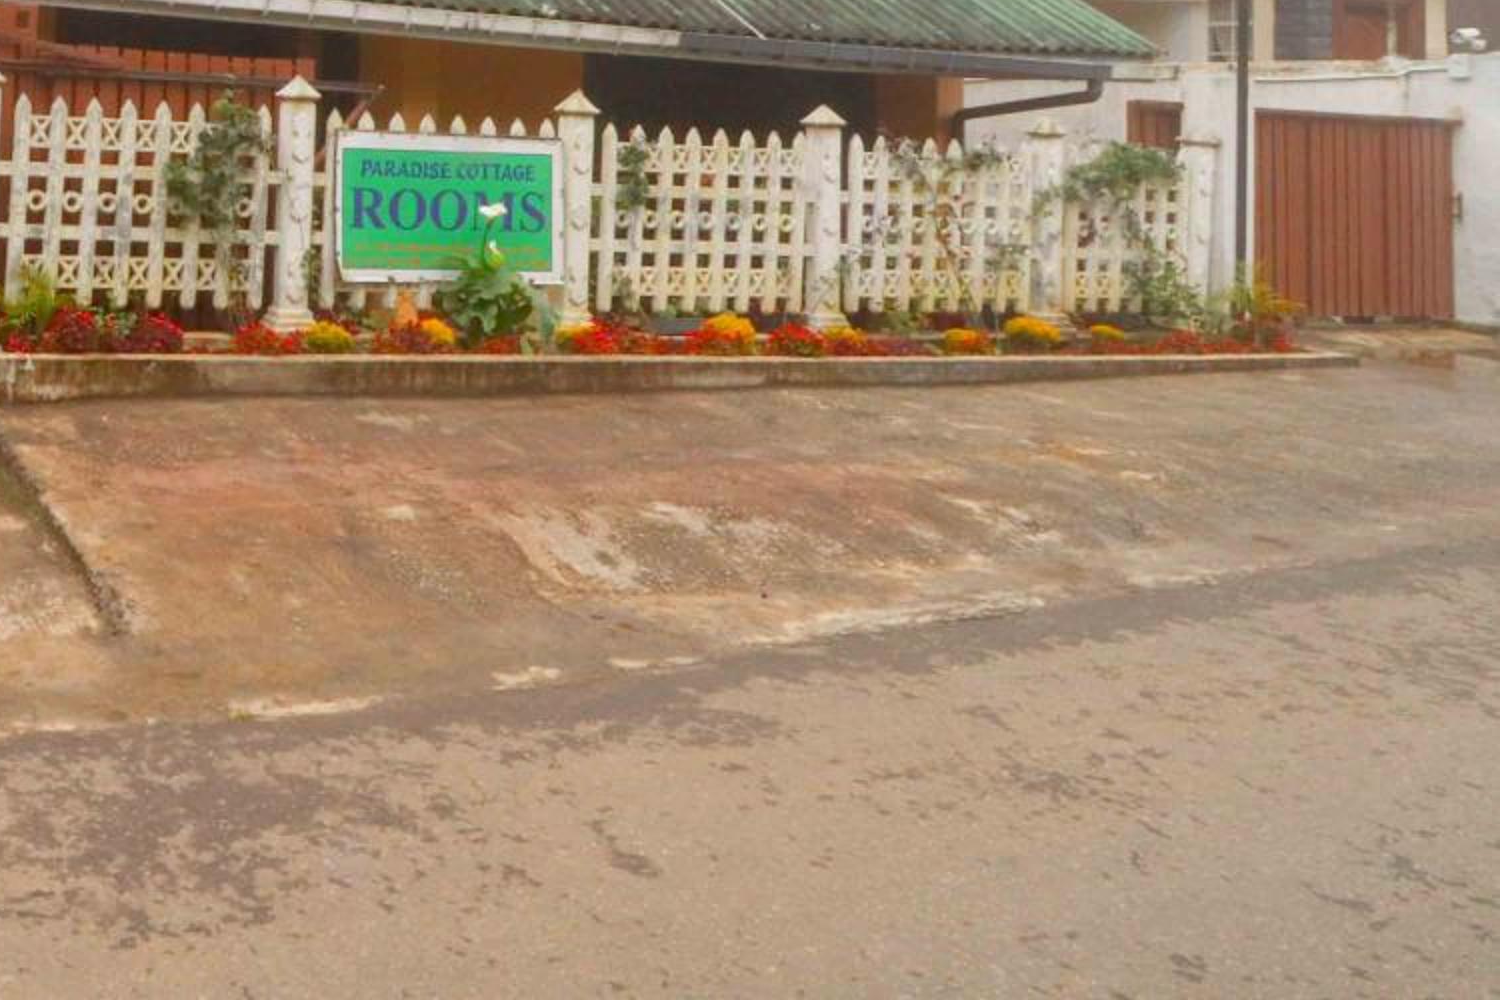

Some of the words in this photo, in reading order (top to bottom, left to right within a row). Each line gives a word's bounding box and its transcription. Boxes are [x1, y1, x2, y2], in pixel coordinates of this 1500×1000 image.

[361, 159, 451, 180] PARADISE
[456, 163, 535, 182] COTTAGE
[351, 186, 547, 233] ROOMS
